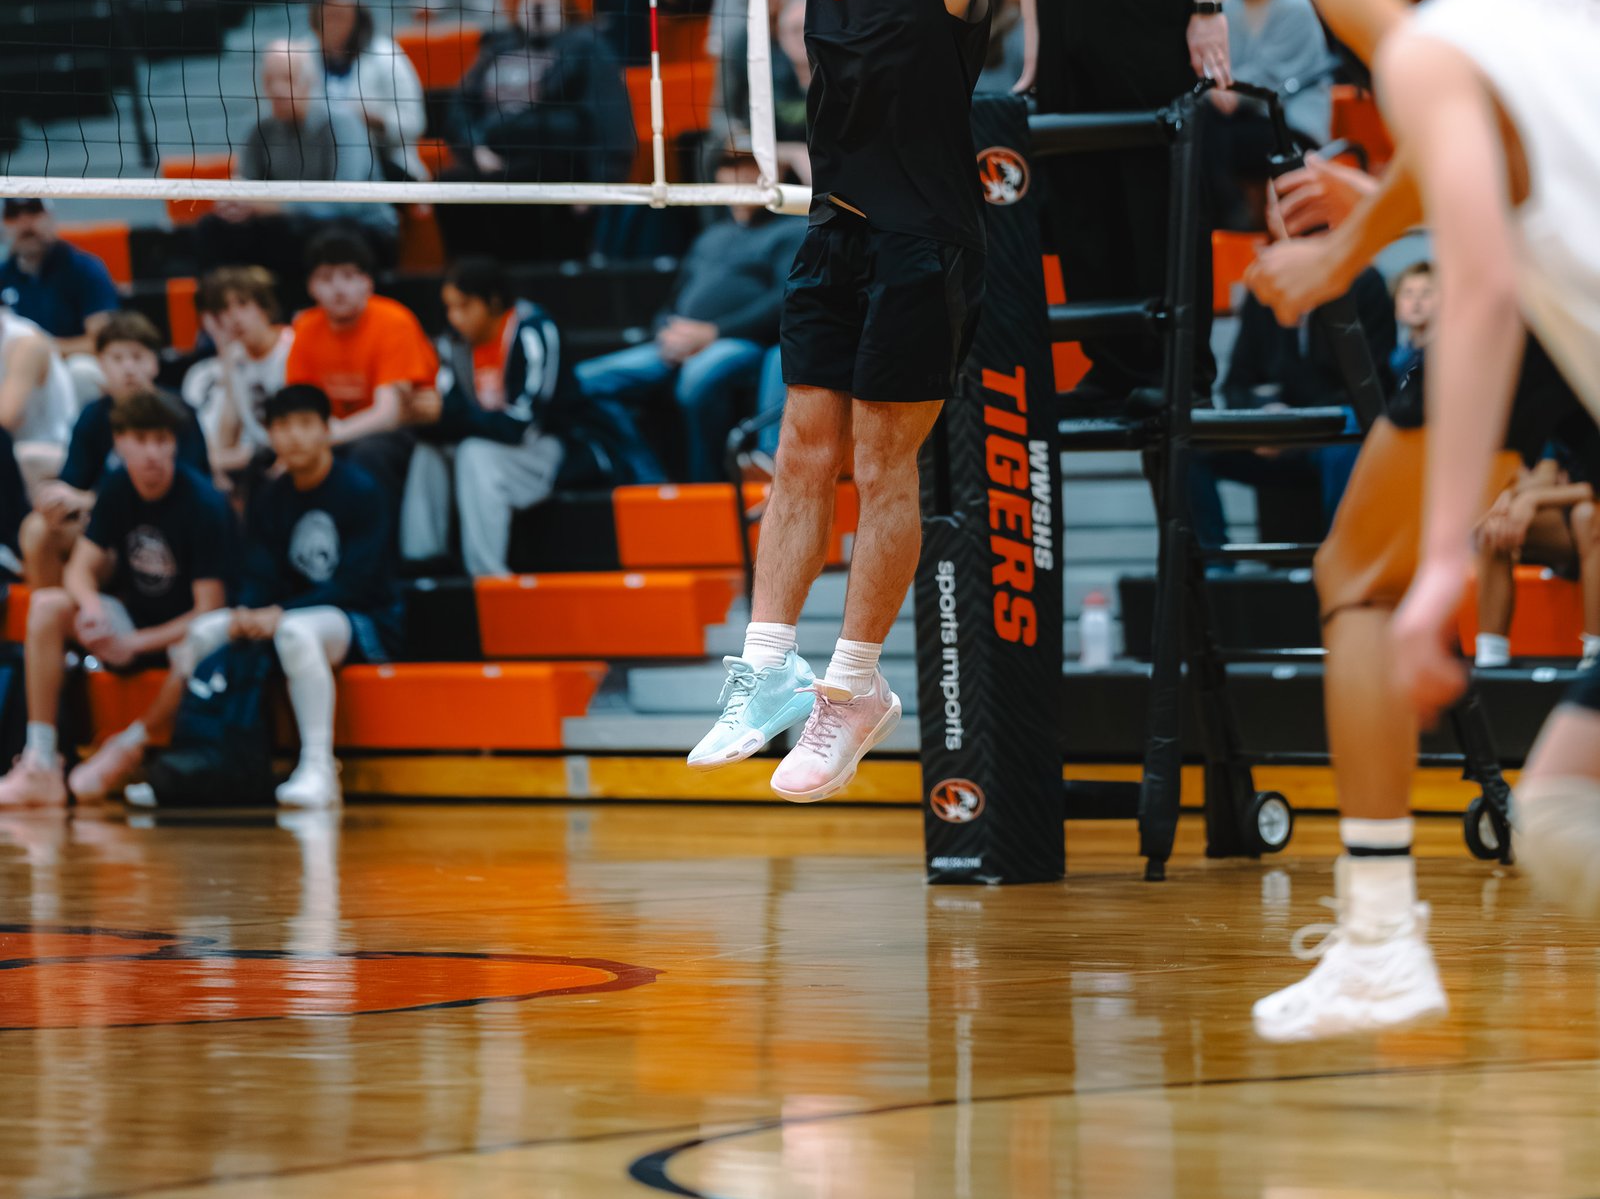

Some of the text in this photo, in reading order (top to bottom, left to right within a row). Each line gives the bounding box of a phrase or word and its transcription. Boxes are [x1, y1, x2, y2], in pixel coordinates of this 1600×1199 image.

[981, 365, 1037, 647] TIGERS
[1028, 439, 1054, 571] WWSHS
[935, 560, 964, 751] sports imports
